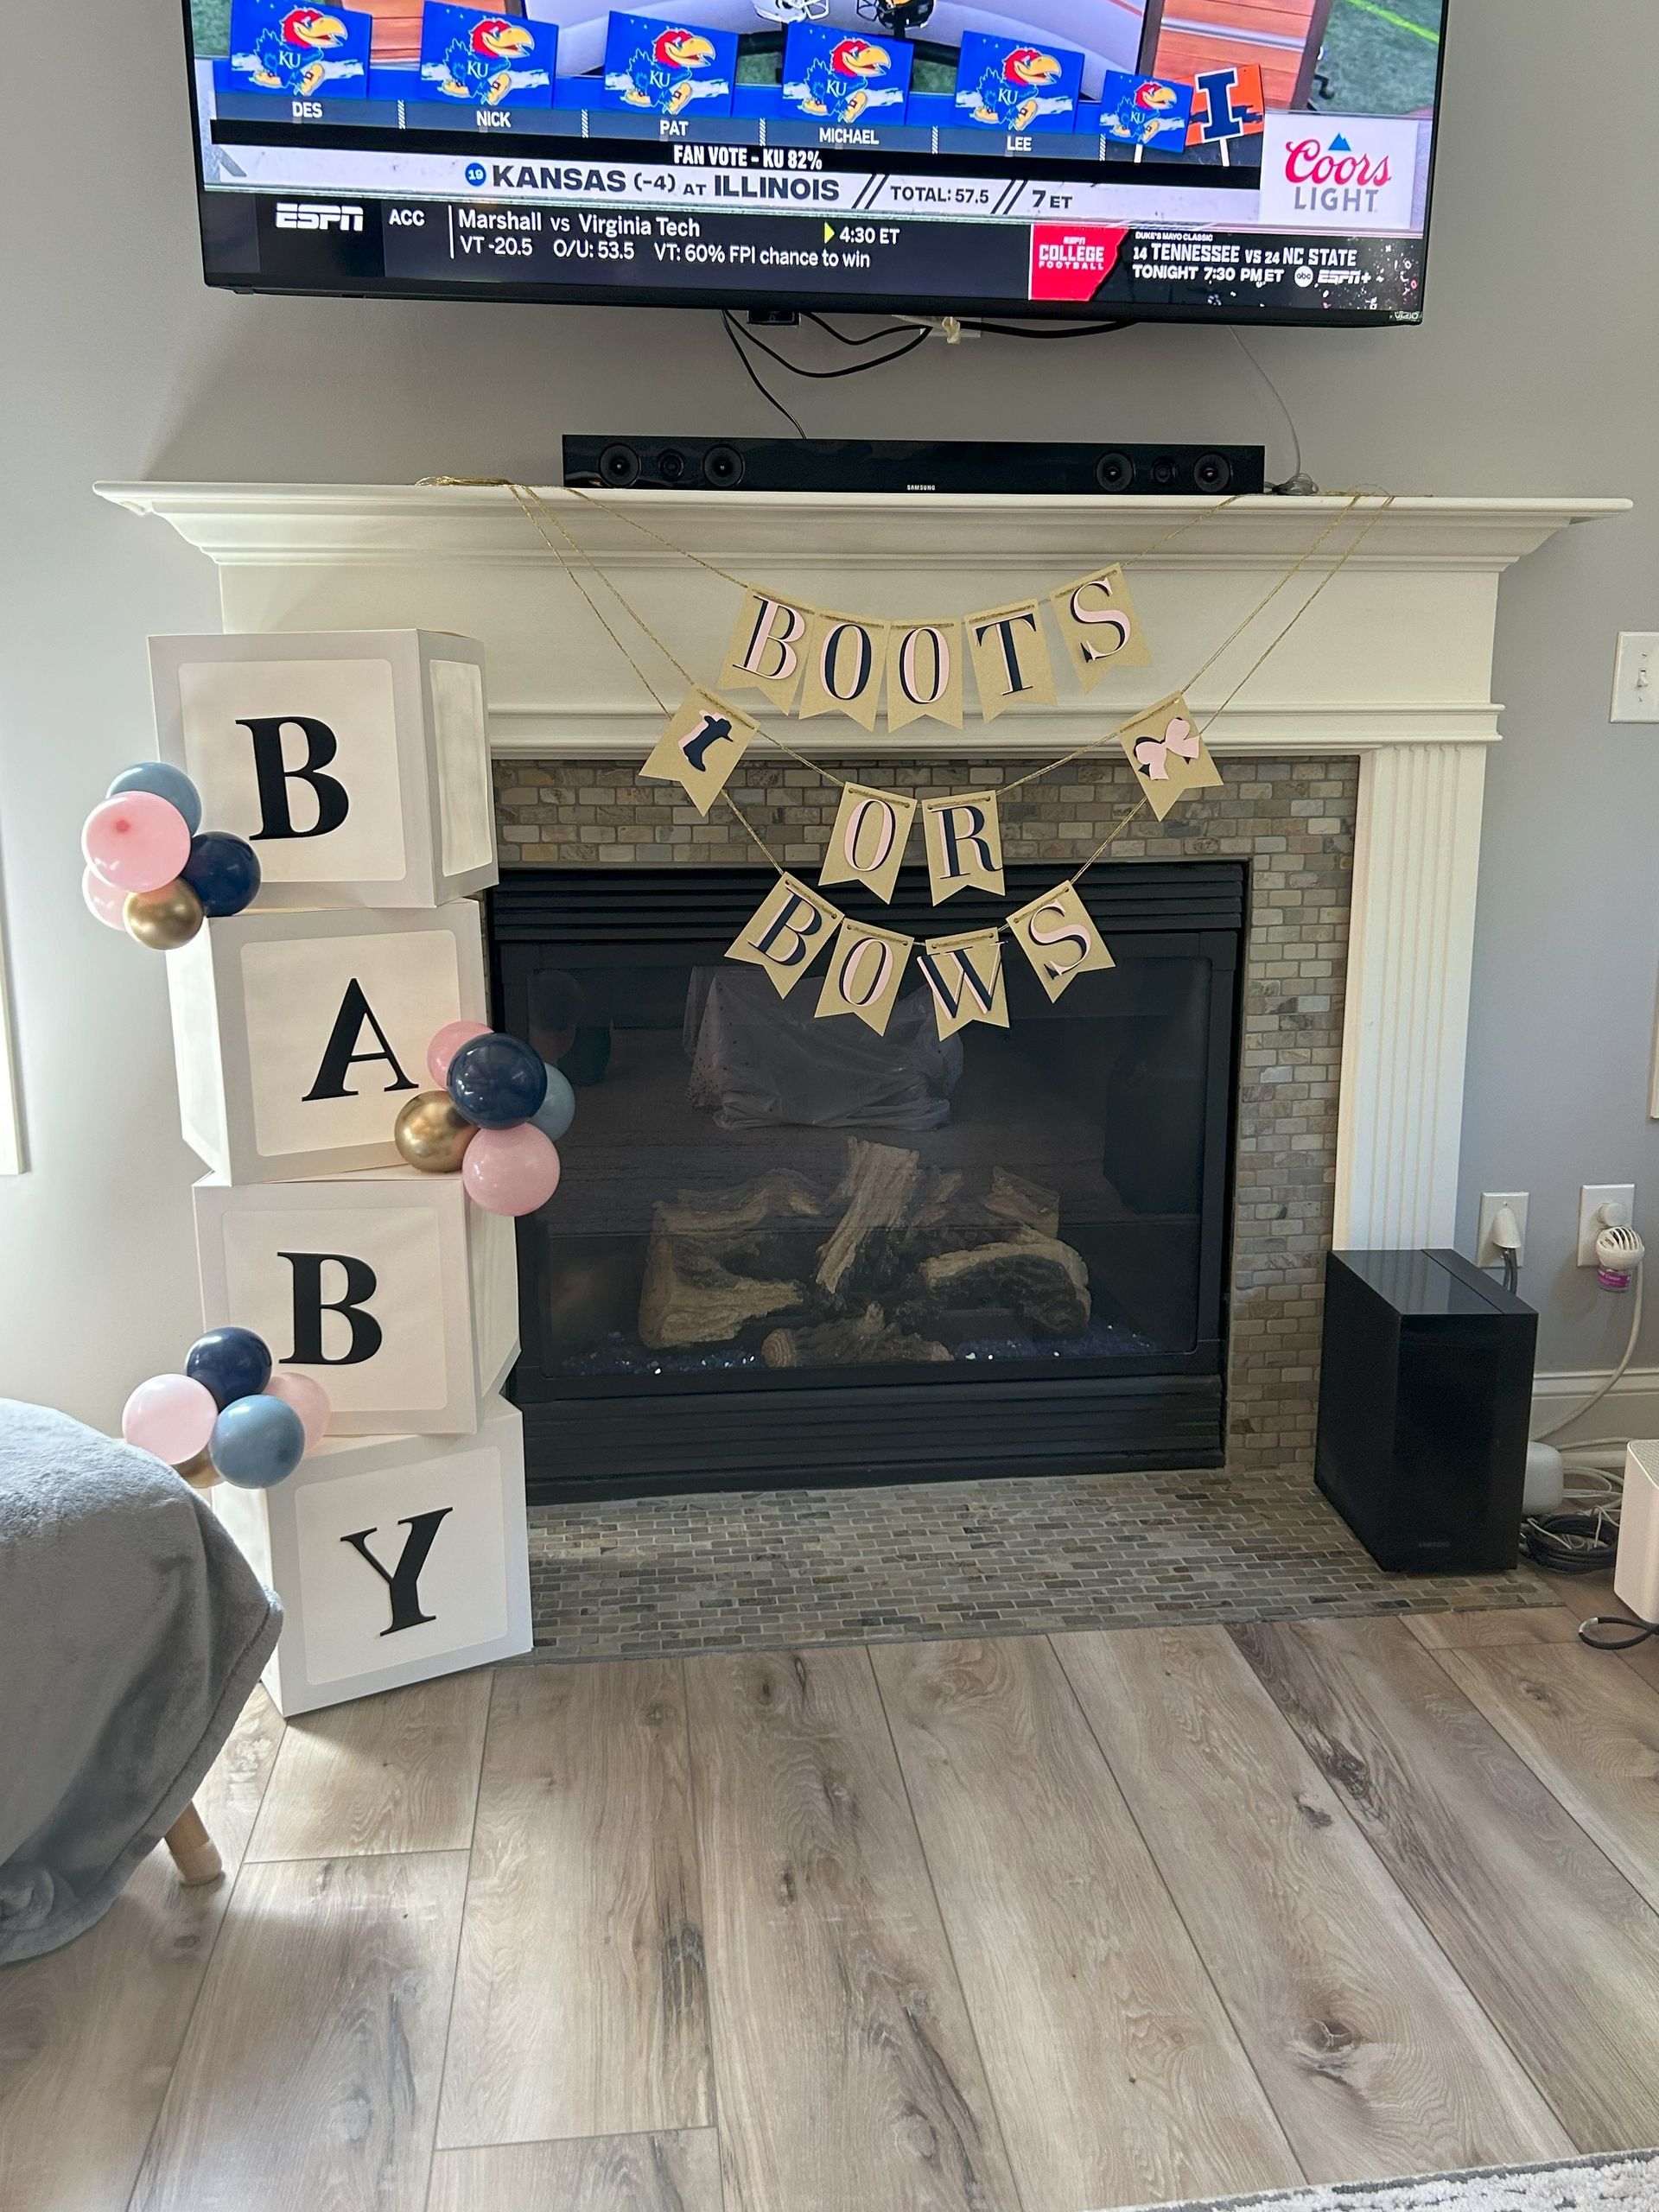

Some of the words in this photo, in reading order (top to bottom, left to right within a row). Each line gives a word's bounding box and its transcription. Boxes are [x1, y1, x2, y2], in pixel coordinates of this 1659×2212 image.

[278, 50, 301, 68] KU
[467, 60, 488, 77] KU
[649, 71, 671, 87] KU
[826, 79, 848, 96] KU
[997, 88, 1019, 105] KU
[292, 101, 323, 118] DES
[1129, 111, 1145, 124] KU
[476, 110, 512, 128] NICK
[659, 119, 689, 137] PAT
[819, 127, 880, 145] MICHAEL
[1007, 136, 1033, 152] LEE
[674, 144, 704, 165] FAN
[708, 146, 747, 167] VOTE
[763, 149, 785, 168] KU
[788, 149, 823, 170] 82%
[1285, 139, 1392, 187] Coors
[467, 168, 484, 181] 19
[493, 165, 626, 193] KANSAS
[633, 172, 676, 194] (-4)
[683, 183, 707, 196] AT
[715, 175, 840, 201] ILLINOIS
[891, 185, 951, 203] TOTAL:
[955, 188, 989, 204] 57.5
[1033, 190, 1046, 207] 7
[1050, 195, 1073, 208] ET
[1294, 186, 1379, 213] LIGHT
[276, 202, 364, 232] ESPN
[389, 208, 425, 226] ACC
[458, 208, 542, 232] Marshall
[550, 217, 570, 232] vs
[579, 213, 652, 238] Virginia
[656, 216, 701, 237] Tech
[839, 226, 875, 244] 4:30
[879, 228, 899, 245] ET
[1135, 231, 1161, 240] DUKE'S
[1162, 232, 1182, 241] MAYO
[1183, 233, 1213, 242] CLASSIC
[460, 235, 485, 254] VT
[488, 238, 533, 256] -20.5
[553, 238, 594, 258] O/U:
[598, 240, 634, 259] 53.5
[654, 242, 681, 261] VT:
[684, 244, 725, 264] 60%
[729, 245, 756, 264] FPI
[760, 246, 818, 266] chance
[822, 249, 839, 267] to
[842, 250, 871, 268] win
[1039, 244, 1104, 262] COLLEGE
[1133, 246, 1147, 260] 14
[1151, 243, 1241, 263] TENNESSEE
[1244, 249, 1262, 264] VS
[1264, 251, 1281, 265] 24
[1283, 247, 1304, 265] NC
[1308, 248, 1357, 266] STATE
[1039, 260, 1104, 270] FOOTBALL
[1132, 264, 1199, 281] TONIGHT
[1204, 267, 1236, 281] 7:30
[733, 577, 1131, 705] BOOTS
[843, 798, 1002, 880] OR
[747, 893, 1092, 1021] BOWS
